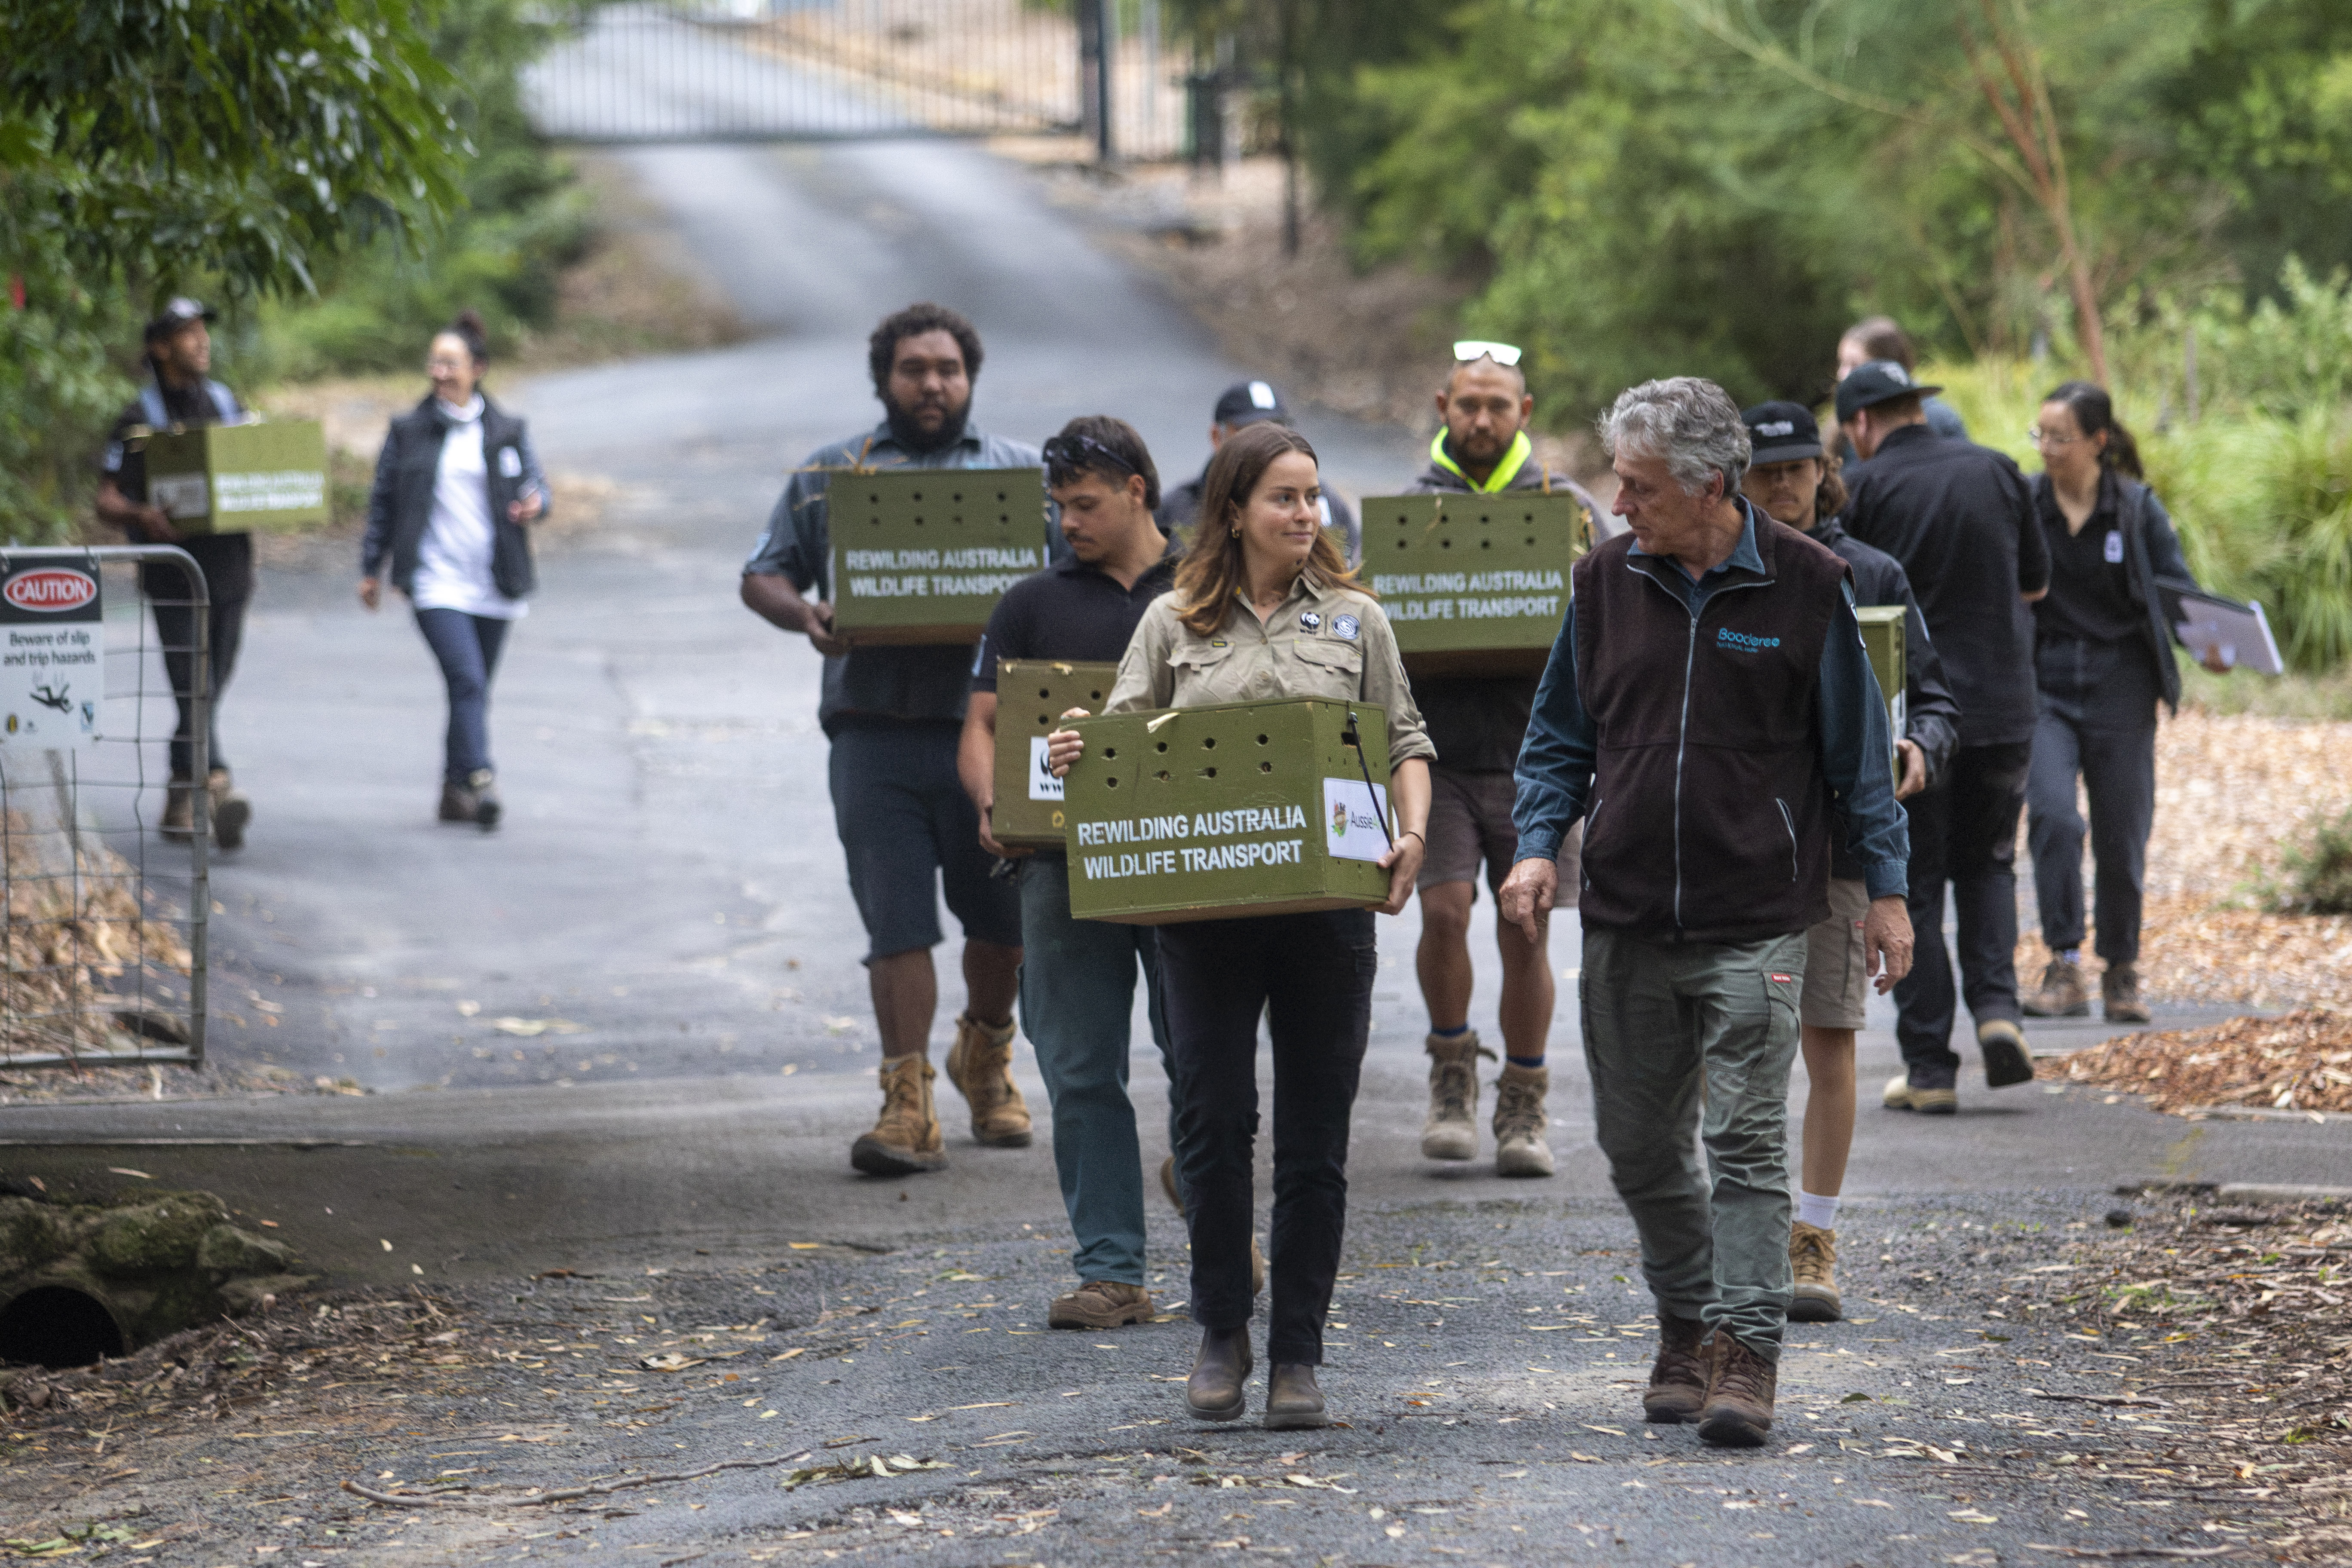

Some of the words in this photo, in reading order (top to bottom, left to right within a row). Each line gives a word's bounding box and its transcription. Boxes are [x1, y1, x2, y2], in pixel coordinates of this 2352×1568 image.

[846, 549, 940, 570] REWILDING
[943, 546, 1038, 569] AUSTRALIA
[12, 579, 88, 601] CAUTION
[850, 575, 929, 597] WILDLIFE
[931, 573, 1030, 596] TRANSPO
[1374, 573, 1465, 594] REWILDING
[1469, 570, 1563, 591] AUSTRALIA
[1458, 596, 1559, 618] TRANSPORT
[10, 630, 53, 645] Beware
[56, 629, 69, 645] of
[70, 630, 90, 647] slip
[4, 652, 26, 665] and
[28, 651, 49, 667] trip
[51, 650, 95, 665] hazards
[1040, 782, 1062, 793] WW
[1078, 814, 1189, 846] REWILDING
[1193, 804, 1307, 837] AUSTRALIA
[1084, 850, 1177, 880] WILDLIFE
[1180, 839, 1303, 872] TRANSPORT
